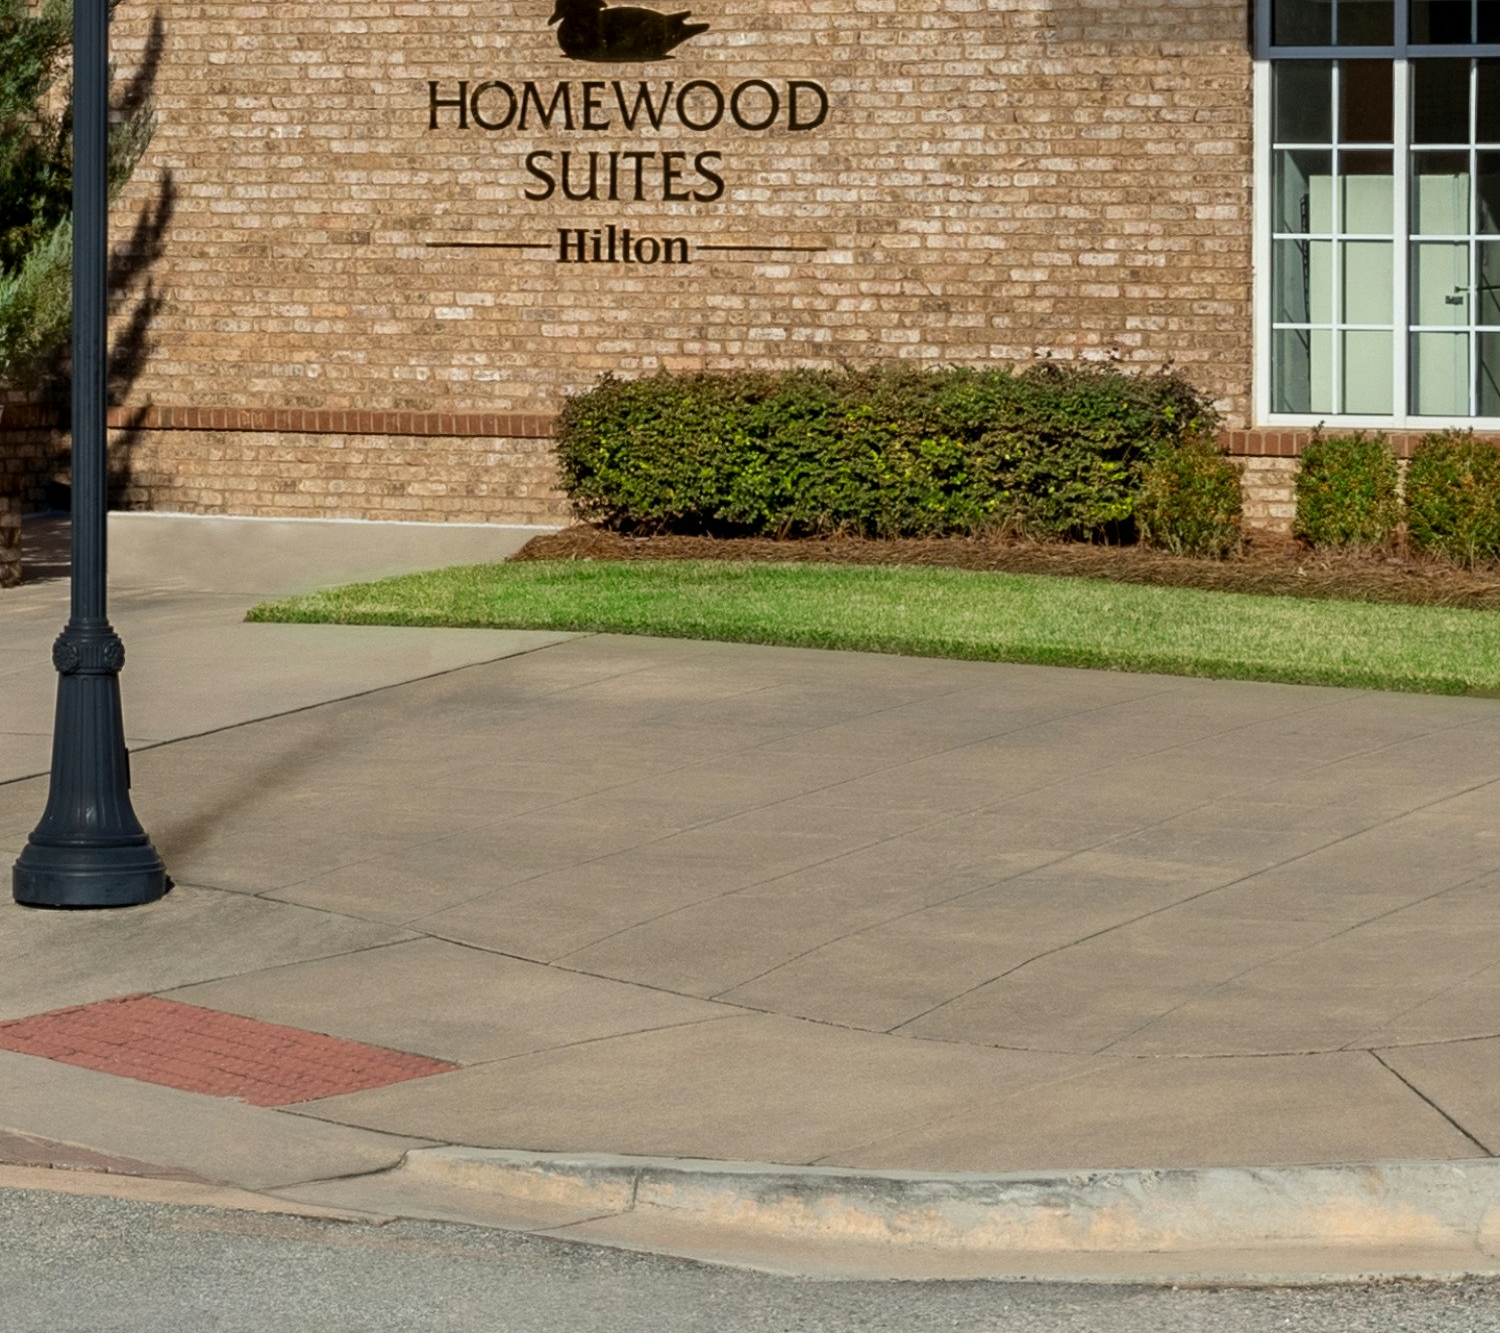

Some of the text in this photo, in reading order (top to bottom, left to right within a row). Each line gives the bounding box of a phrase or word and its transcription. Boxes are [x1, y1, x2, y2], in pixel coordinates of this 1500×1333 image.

[427, 79, 829, 132] HOMEWOOD
[524, 150, 725, 202] SUITES
[556, 225, 692, 264] Hilton
